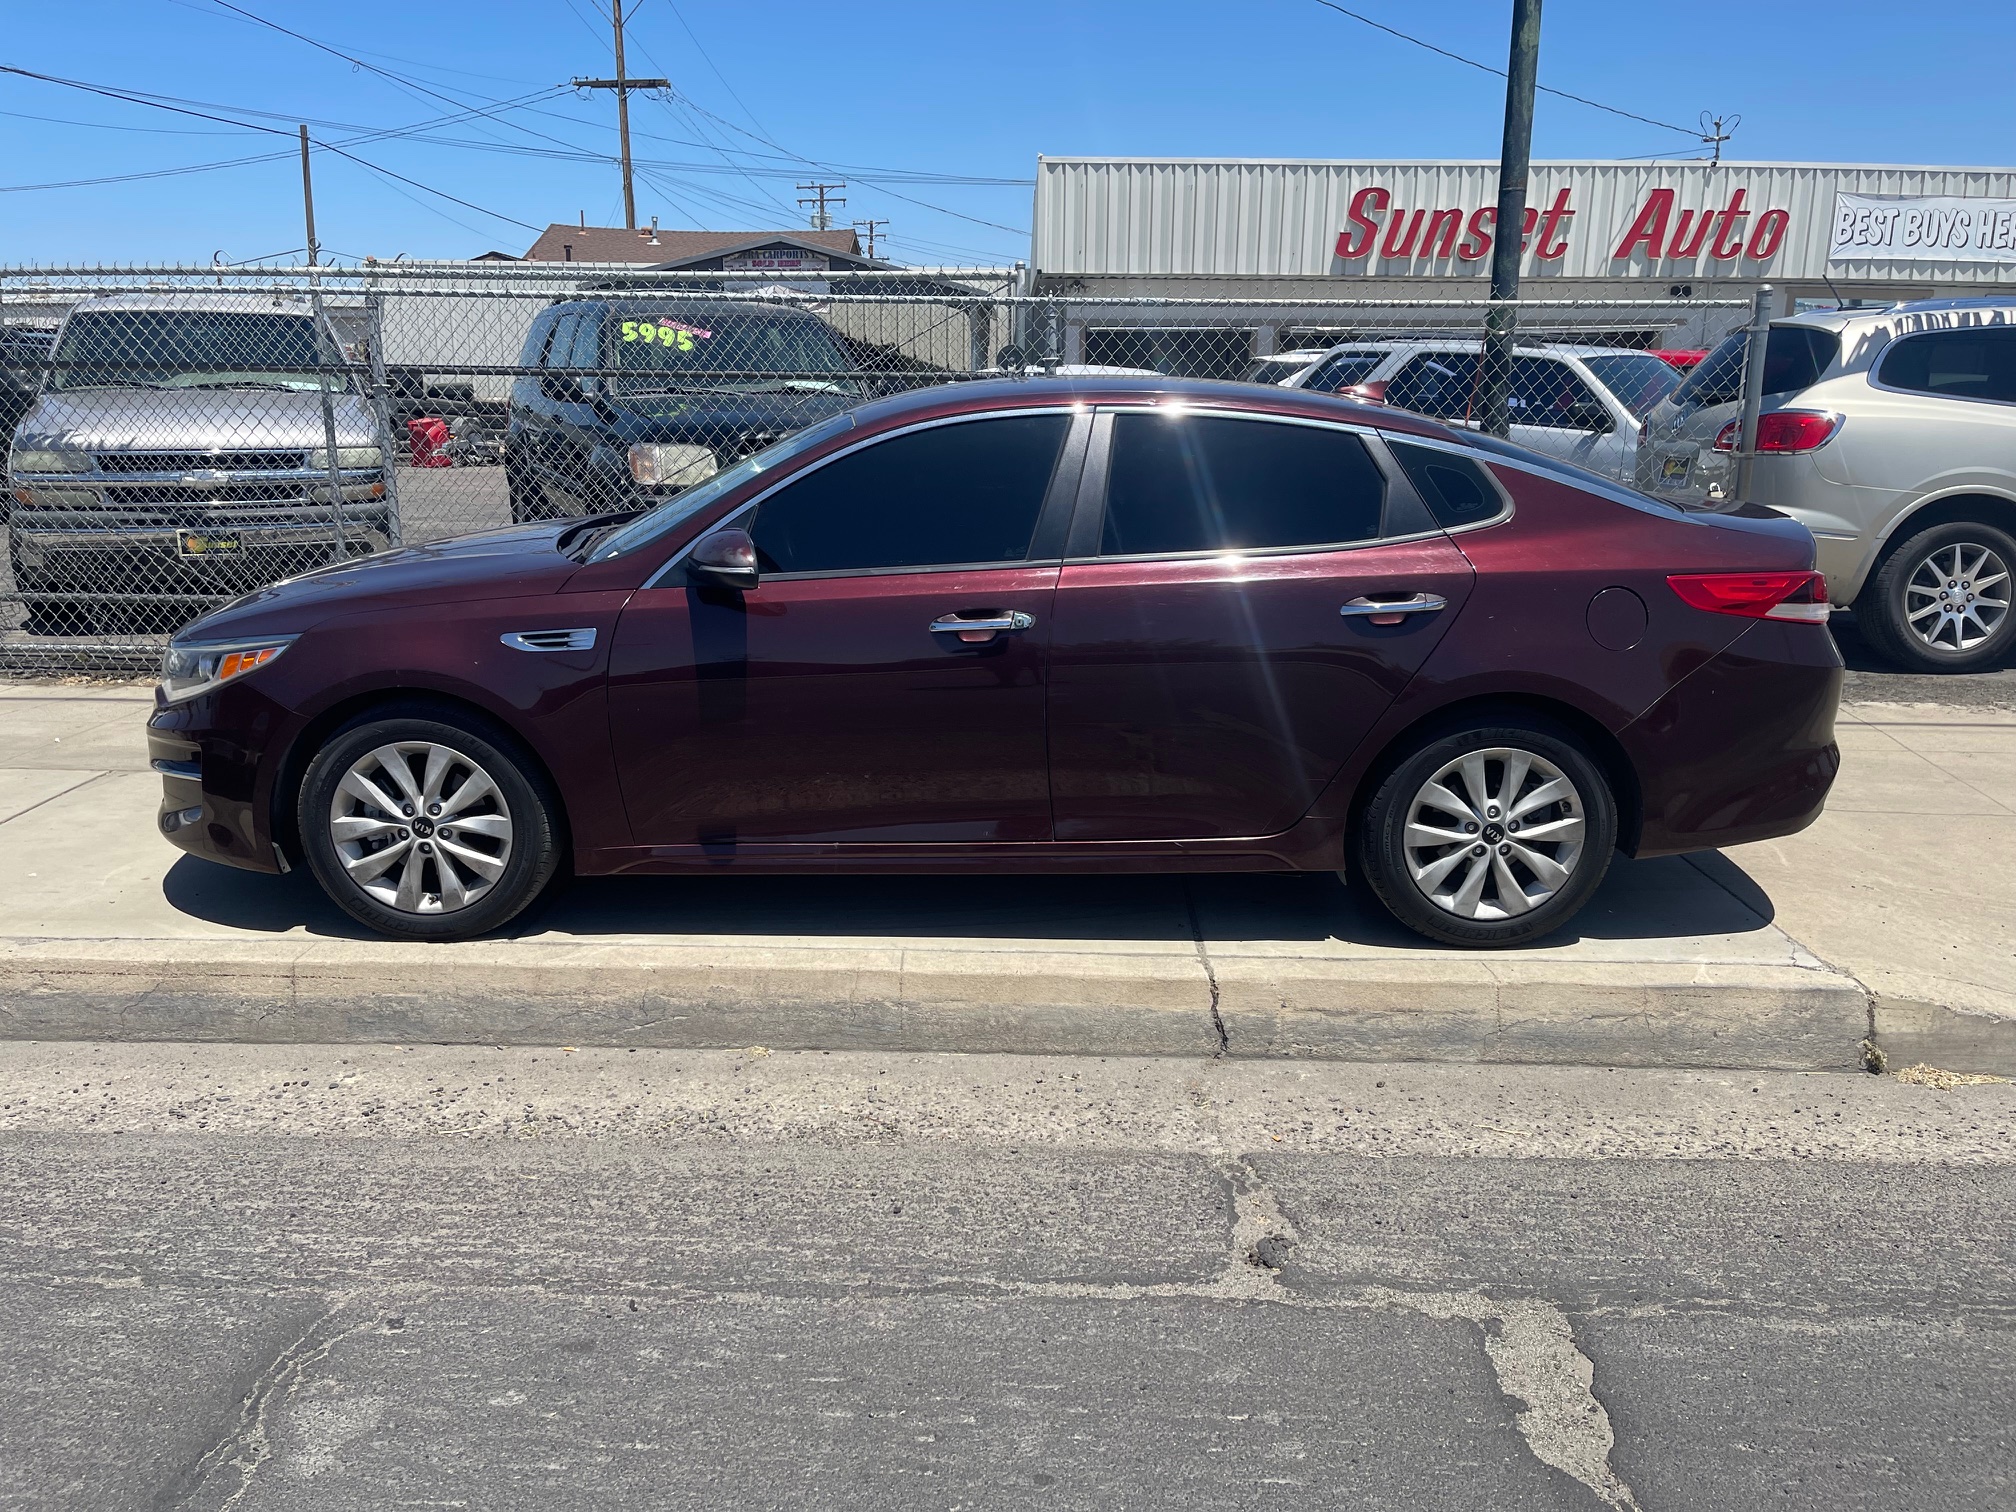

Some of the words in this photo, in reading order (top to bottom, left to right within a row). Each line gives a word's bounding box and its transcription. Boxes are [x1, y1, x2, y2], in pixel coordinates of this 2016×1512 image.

[1613, 188, 1790, 261] Auto
[1834, 205, 1900, 247] BEST
[1902, 207, 1971, 249] BUYS
[621, 321, 694, 351] 5995
[414, 821, 432, 835] KIA
[1486, 826, 1503, 842] KIA
